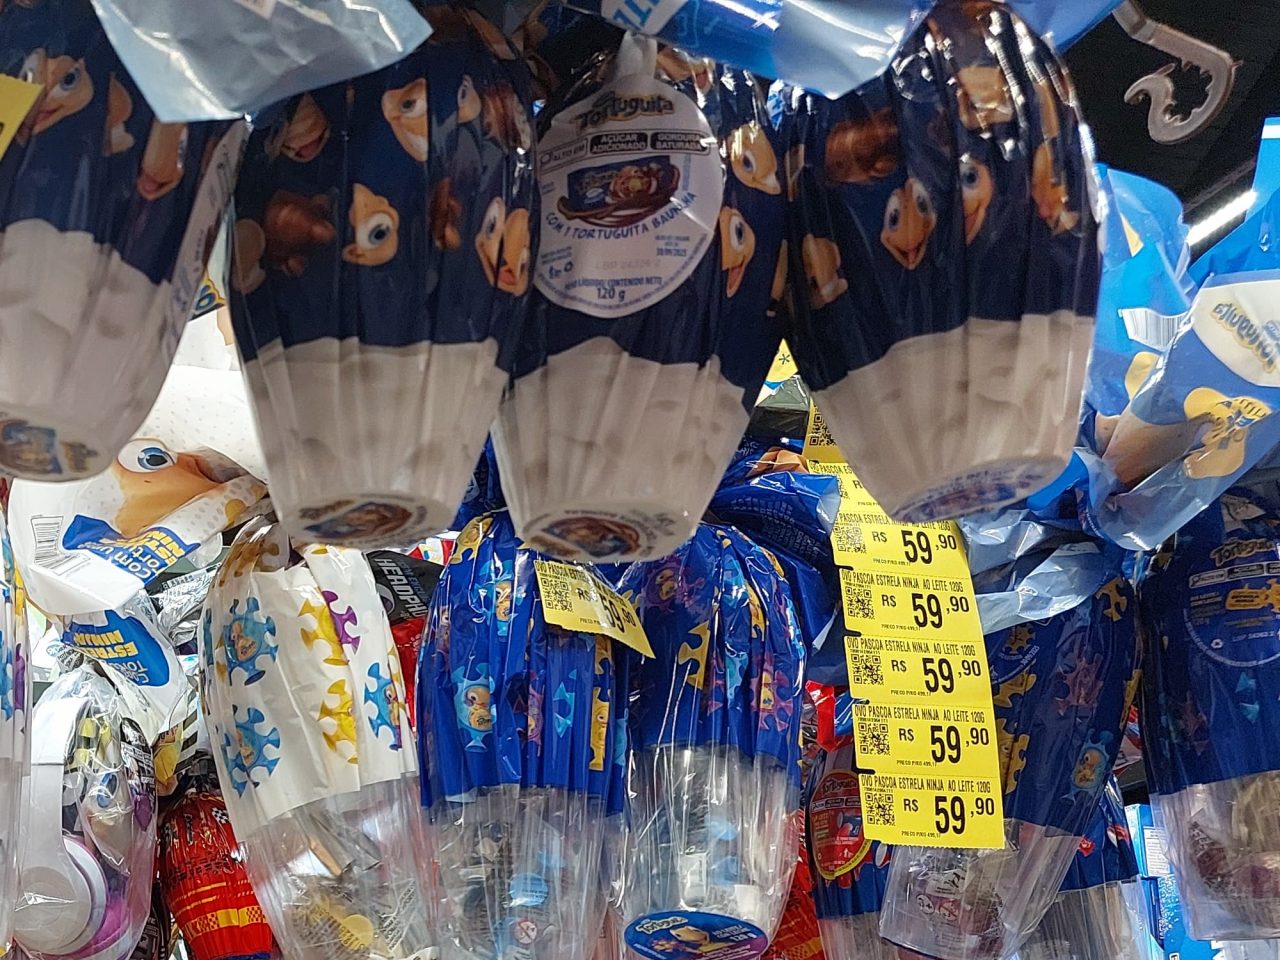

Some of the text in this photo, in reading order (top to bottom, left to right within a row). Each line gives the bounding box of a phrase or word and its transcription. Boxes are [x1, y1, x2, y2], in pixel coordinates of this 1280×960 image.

[546, 211, 563, 235] COM
[572, 223, 649, 240] TORTUGUITA
[597, 287, 626, 301] 120 g
[820, 464, 843, 474] PASCOA
[839, 513, 863, 524] PASCOA
[864, 514, 889, 525] ESTRELA
[872, 531, 888, 543] R$
[842, 570, 964, 592] OVO PASCOA ESTRELA NINJA AO LEITE 120G
[881, 594, 897, 608] R$
[847, 636, 976, 656] OVO PASCOA ESTRELA NINJA AO LEITE 120G
[891, 659, 907, 673] R$
[855, 705, 985, 724] OVO PASCOA ESTRELA NINJA AO LEITE 120G
[899, 728, 914, 742] R$
[861, 774, 991, 793] OVO PASCOA ESTRELA NINJA AO LEITE 120G
[903, 798, 919, 812] R$
